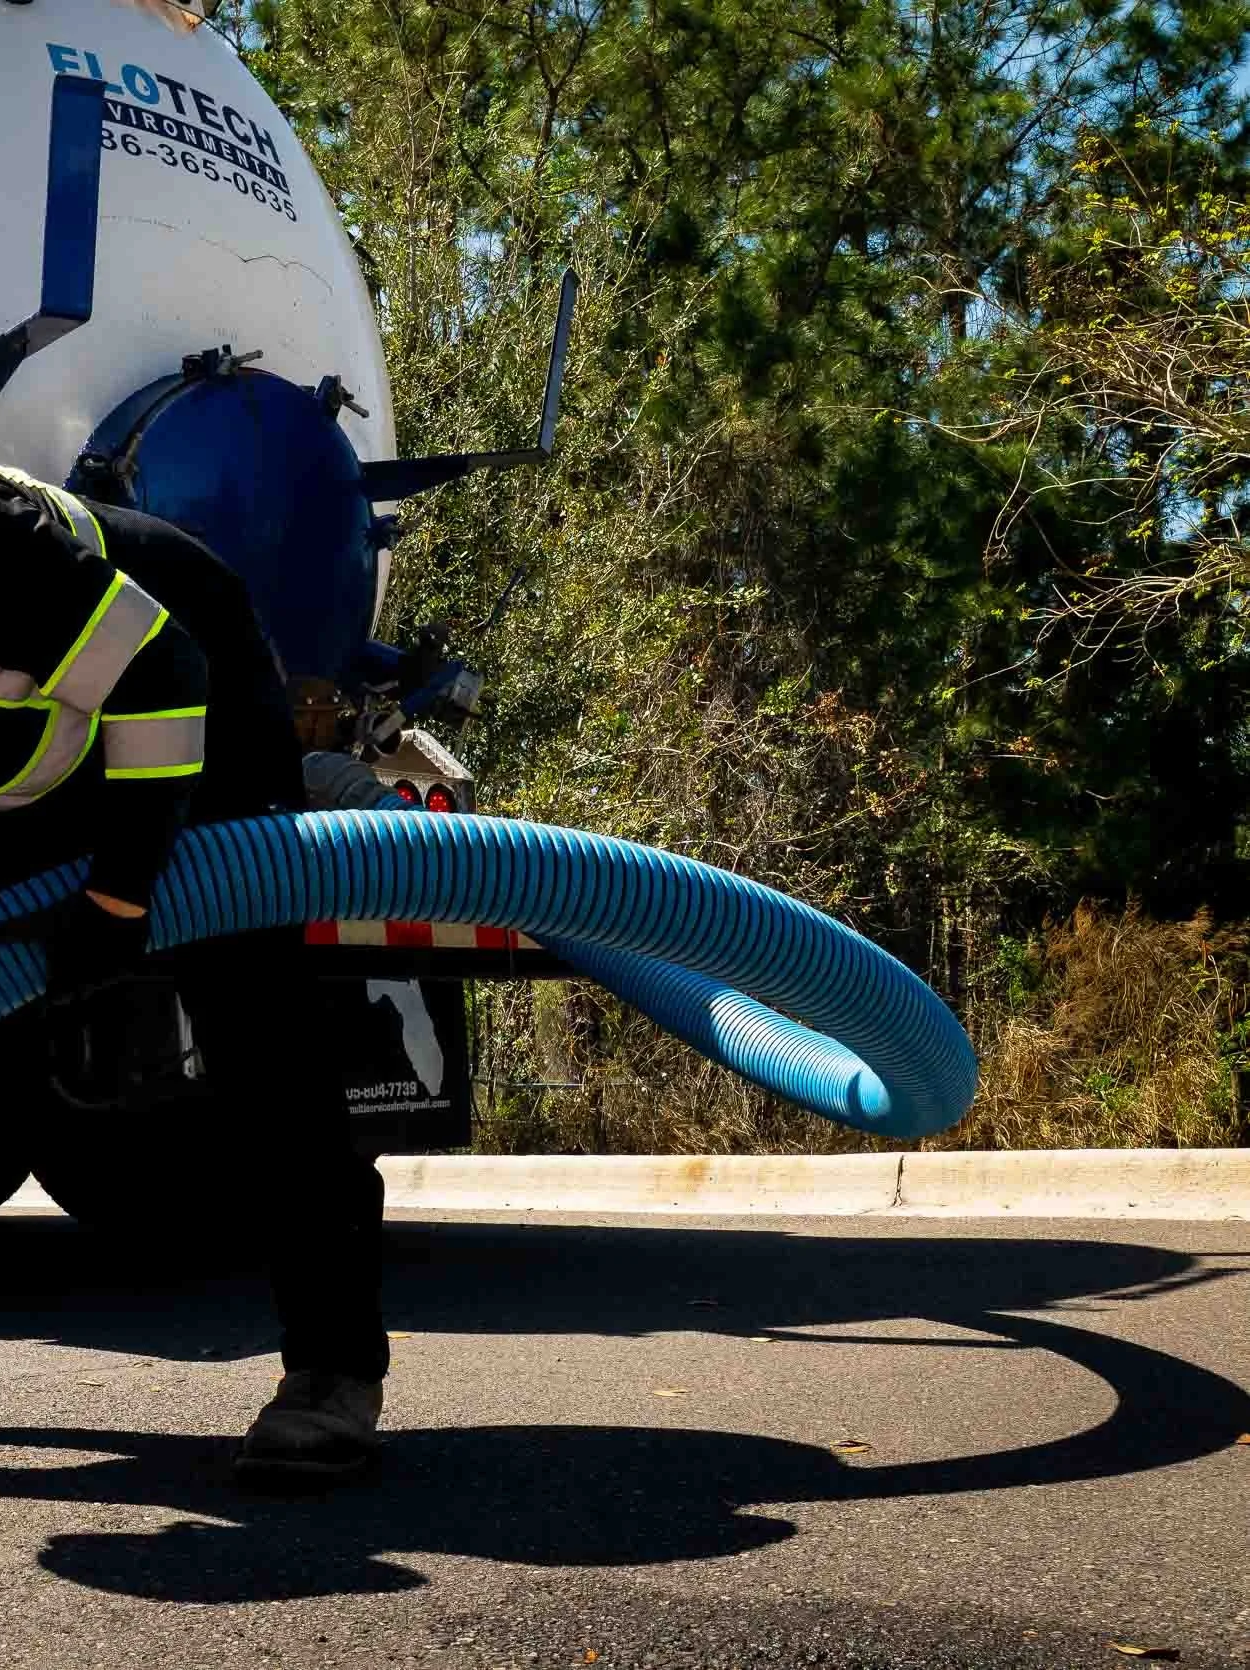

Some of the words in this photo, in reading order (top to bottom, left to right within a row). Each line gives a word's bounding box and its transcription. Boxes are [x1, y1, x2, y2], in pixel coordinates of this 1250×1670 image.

[46, 43, 282, 166] FLOTECH
[105, 102, 288, 192] VIRONMENTAL
[102, 128, 297, 222] 86-365-0635
